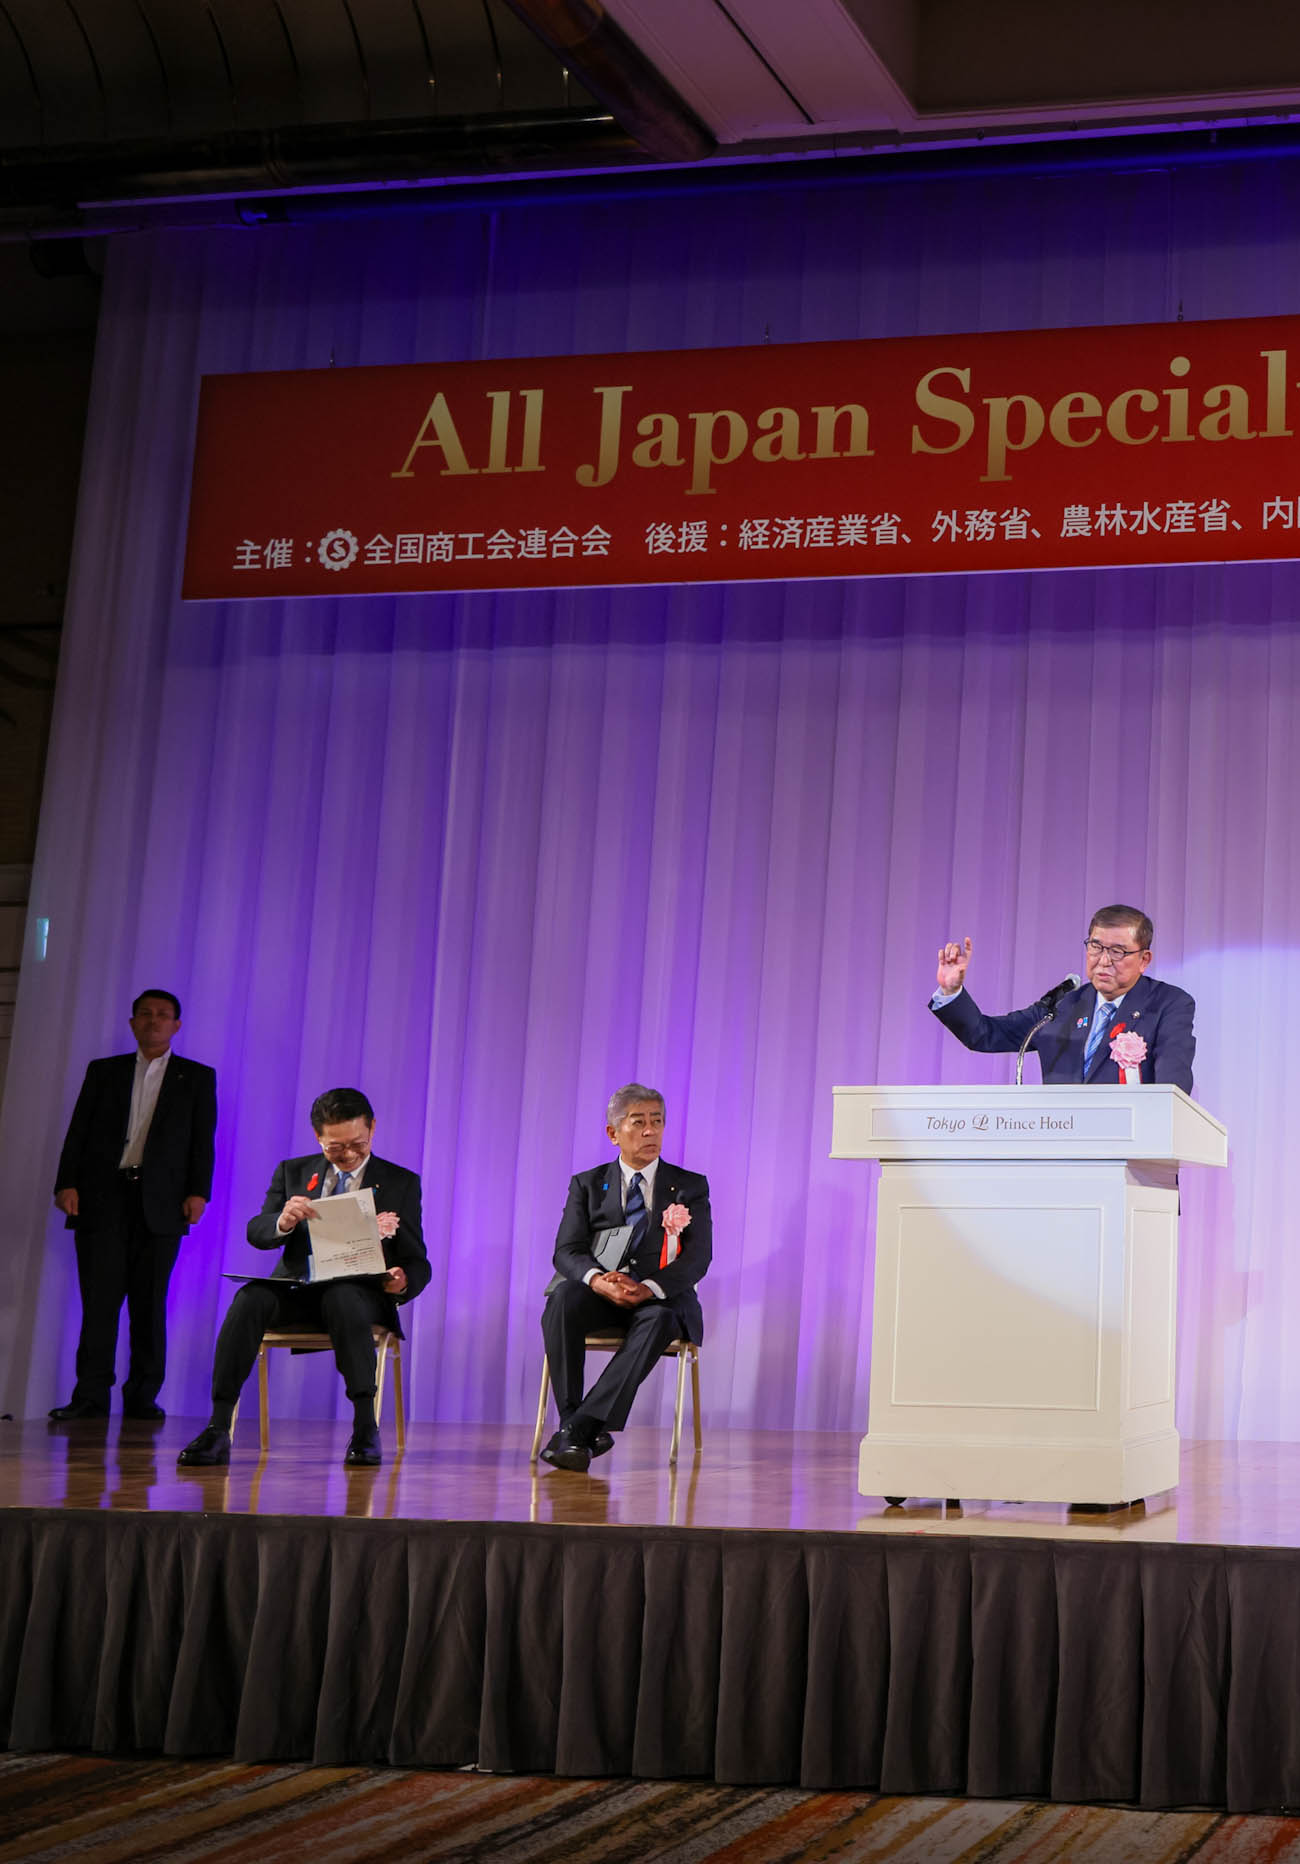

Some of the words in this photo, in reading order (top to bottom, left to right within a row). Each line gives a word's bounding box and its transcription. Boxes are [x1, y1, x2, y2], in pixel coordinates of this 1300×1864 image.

[391, 388, 545, 478] All
[575, 385, 875, 495] Japan
[926, 1116, 965, 1133] Tokyo
[995, 1116, 1036, 1130] Prince
[1040, 1115, 1074, 1130] Hotel
